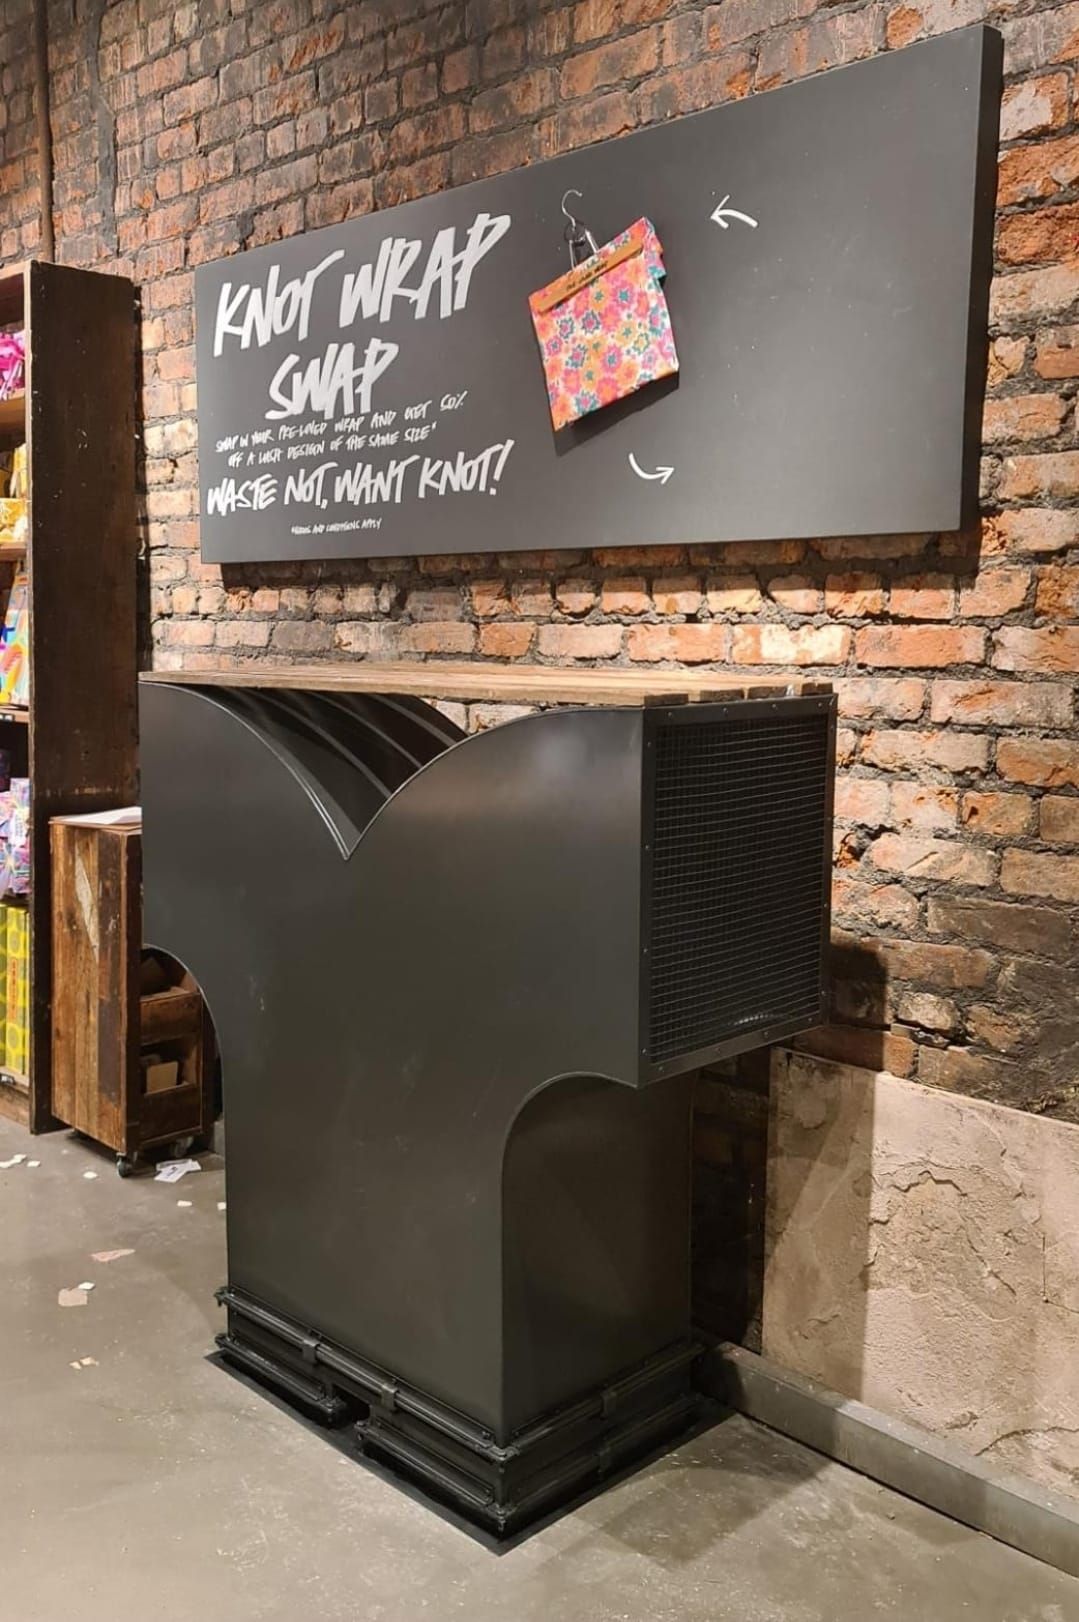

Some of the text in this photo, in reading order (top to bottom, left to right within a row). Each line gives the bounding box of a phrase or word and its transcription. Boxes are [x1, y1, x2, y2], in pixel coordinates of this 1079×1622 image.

[213, 213, 511, 357] KNOT WRAP
[265, 338, 400, 420] SWAP
[216, 434, 239, 453] SWAP
[251, 429, 274, 446] YOUR
[278, 419, 327, 441] PRE-LOVED
[334, 416, 365, 433] WRAP
[370, 410, 397, 429] AND
[404, 400, 432, 420] GET
[440, 390, 468, 411] 50%
[228, 451, 244, 468] OFF
[246, 453, 256, 466] A
[287, 441, 325, 460] DESIGN
[330, 435, 344, 451] OF
[345, 434, 367, 451] THE
[368, 431, 400, 448] SAME
[207, 439, 515, 516] WASTE NOT, WANT KNOT!
[361, 517, 382, 530] APPLY
